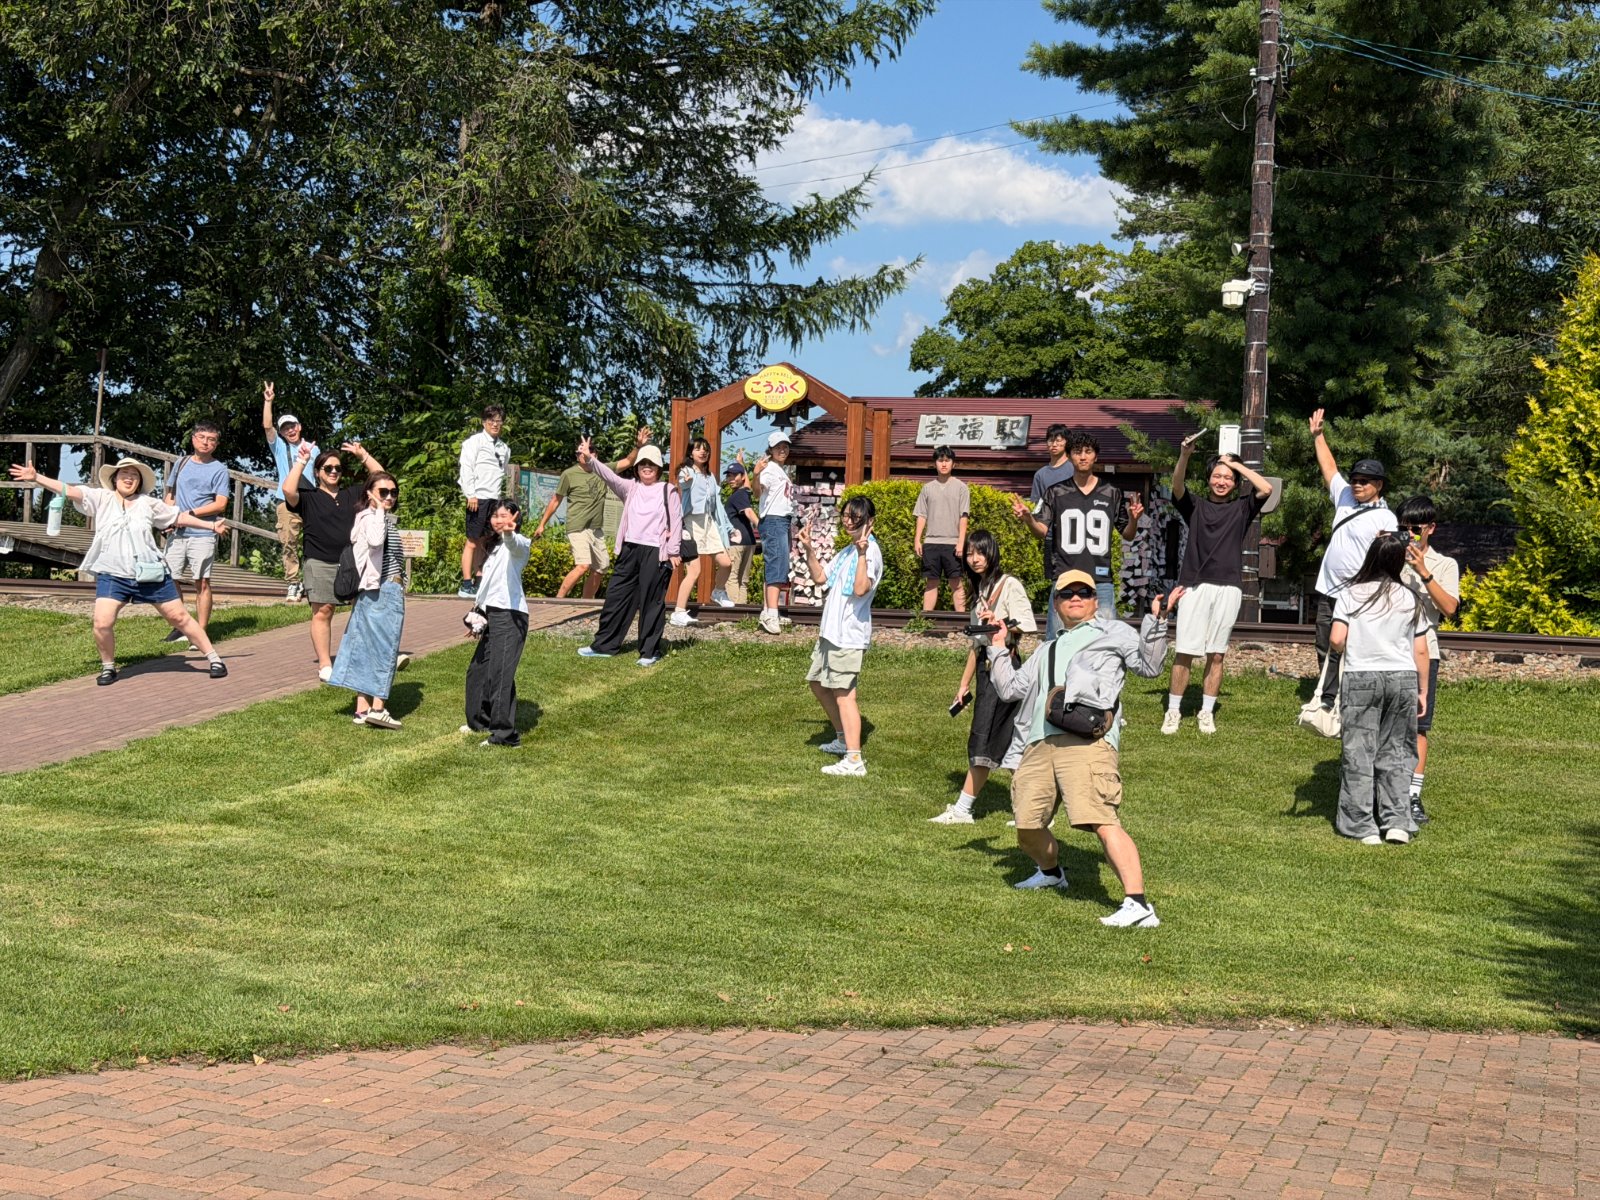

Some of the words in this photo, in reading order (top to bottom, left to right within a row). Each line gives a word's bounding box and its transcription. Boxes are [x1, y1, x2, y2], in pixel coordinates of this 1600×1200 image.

[750, 380, 800, 394] こうふく
[924, 415, 1023, 441] 幸福駅
[1060, 508, 1110, 556] 09
